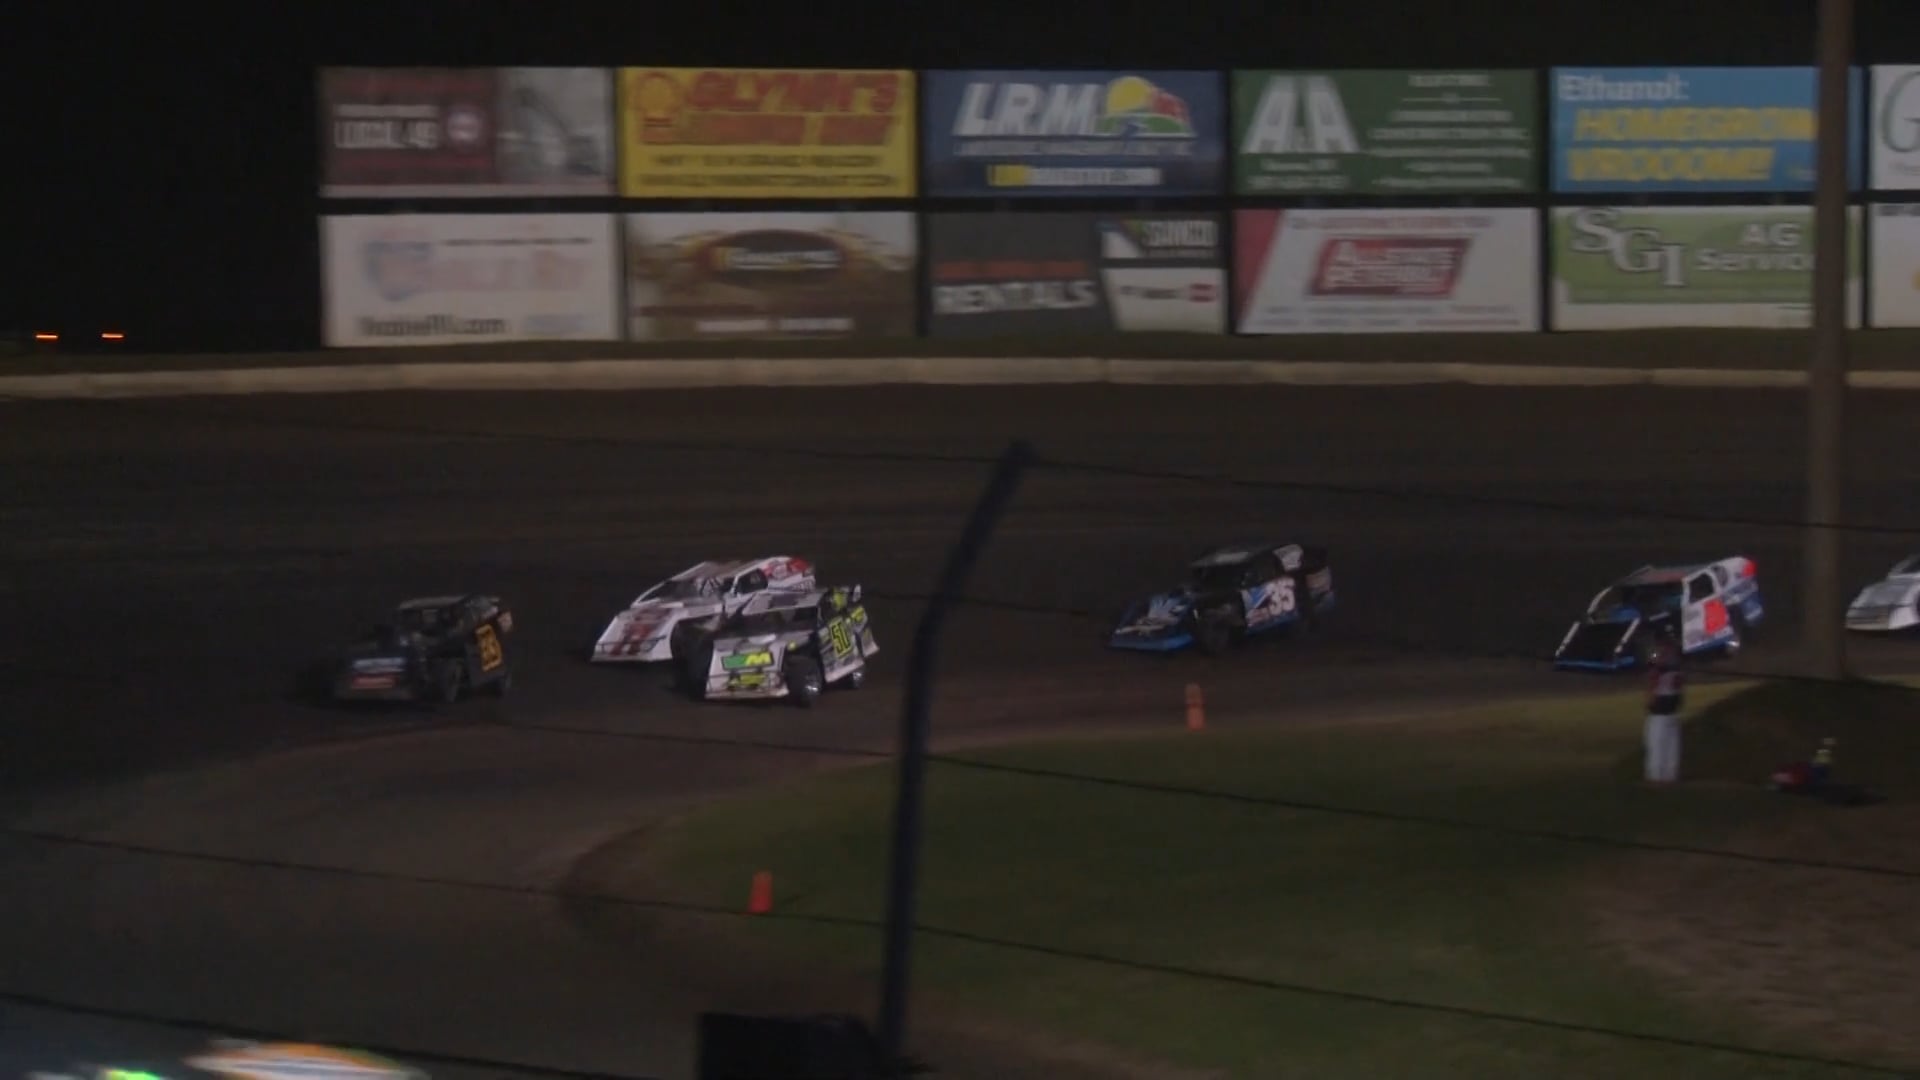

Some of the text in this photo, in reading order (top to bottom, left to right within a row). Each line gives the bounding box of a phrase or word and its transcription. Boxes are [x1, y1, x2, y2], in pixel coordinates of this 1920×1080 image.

[952, 83, 1107, 137] LRM
[1570, 206, 1688, 288] SGI
[1743, 223, 1802, 248] AG
